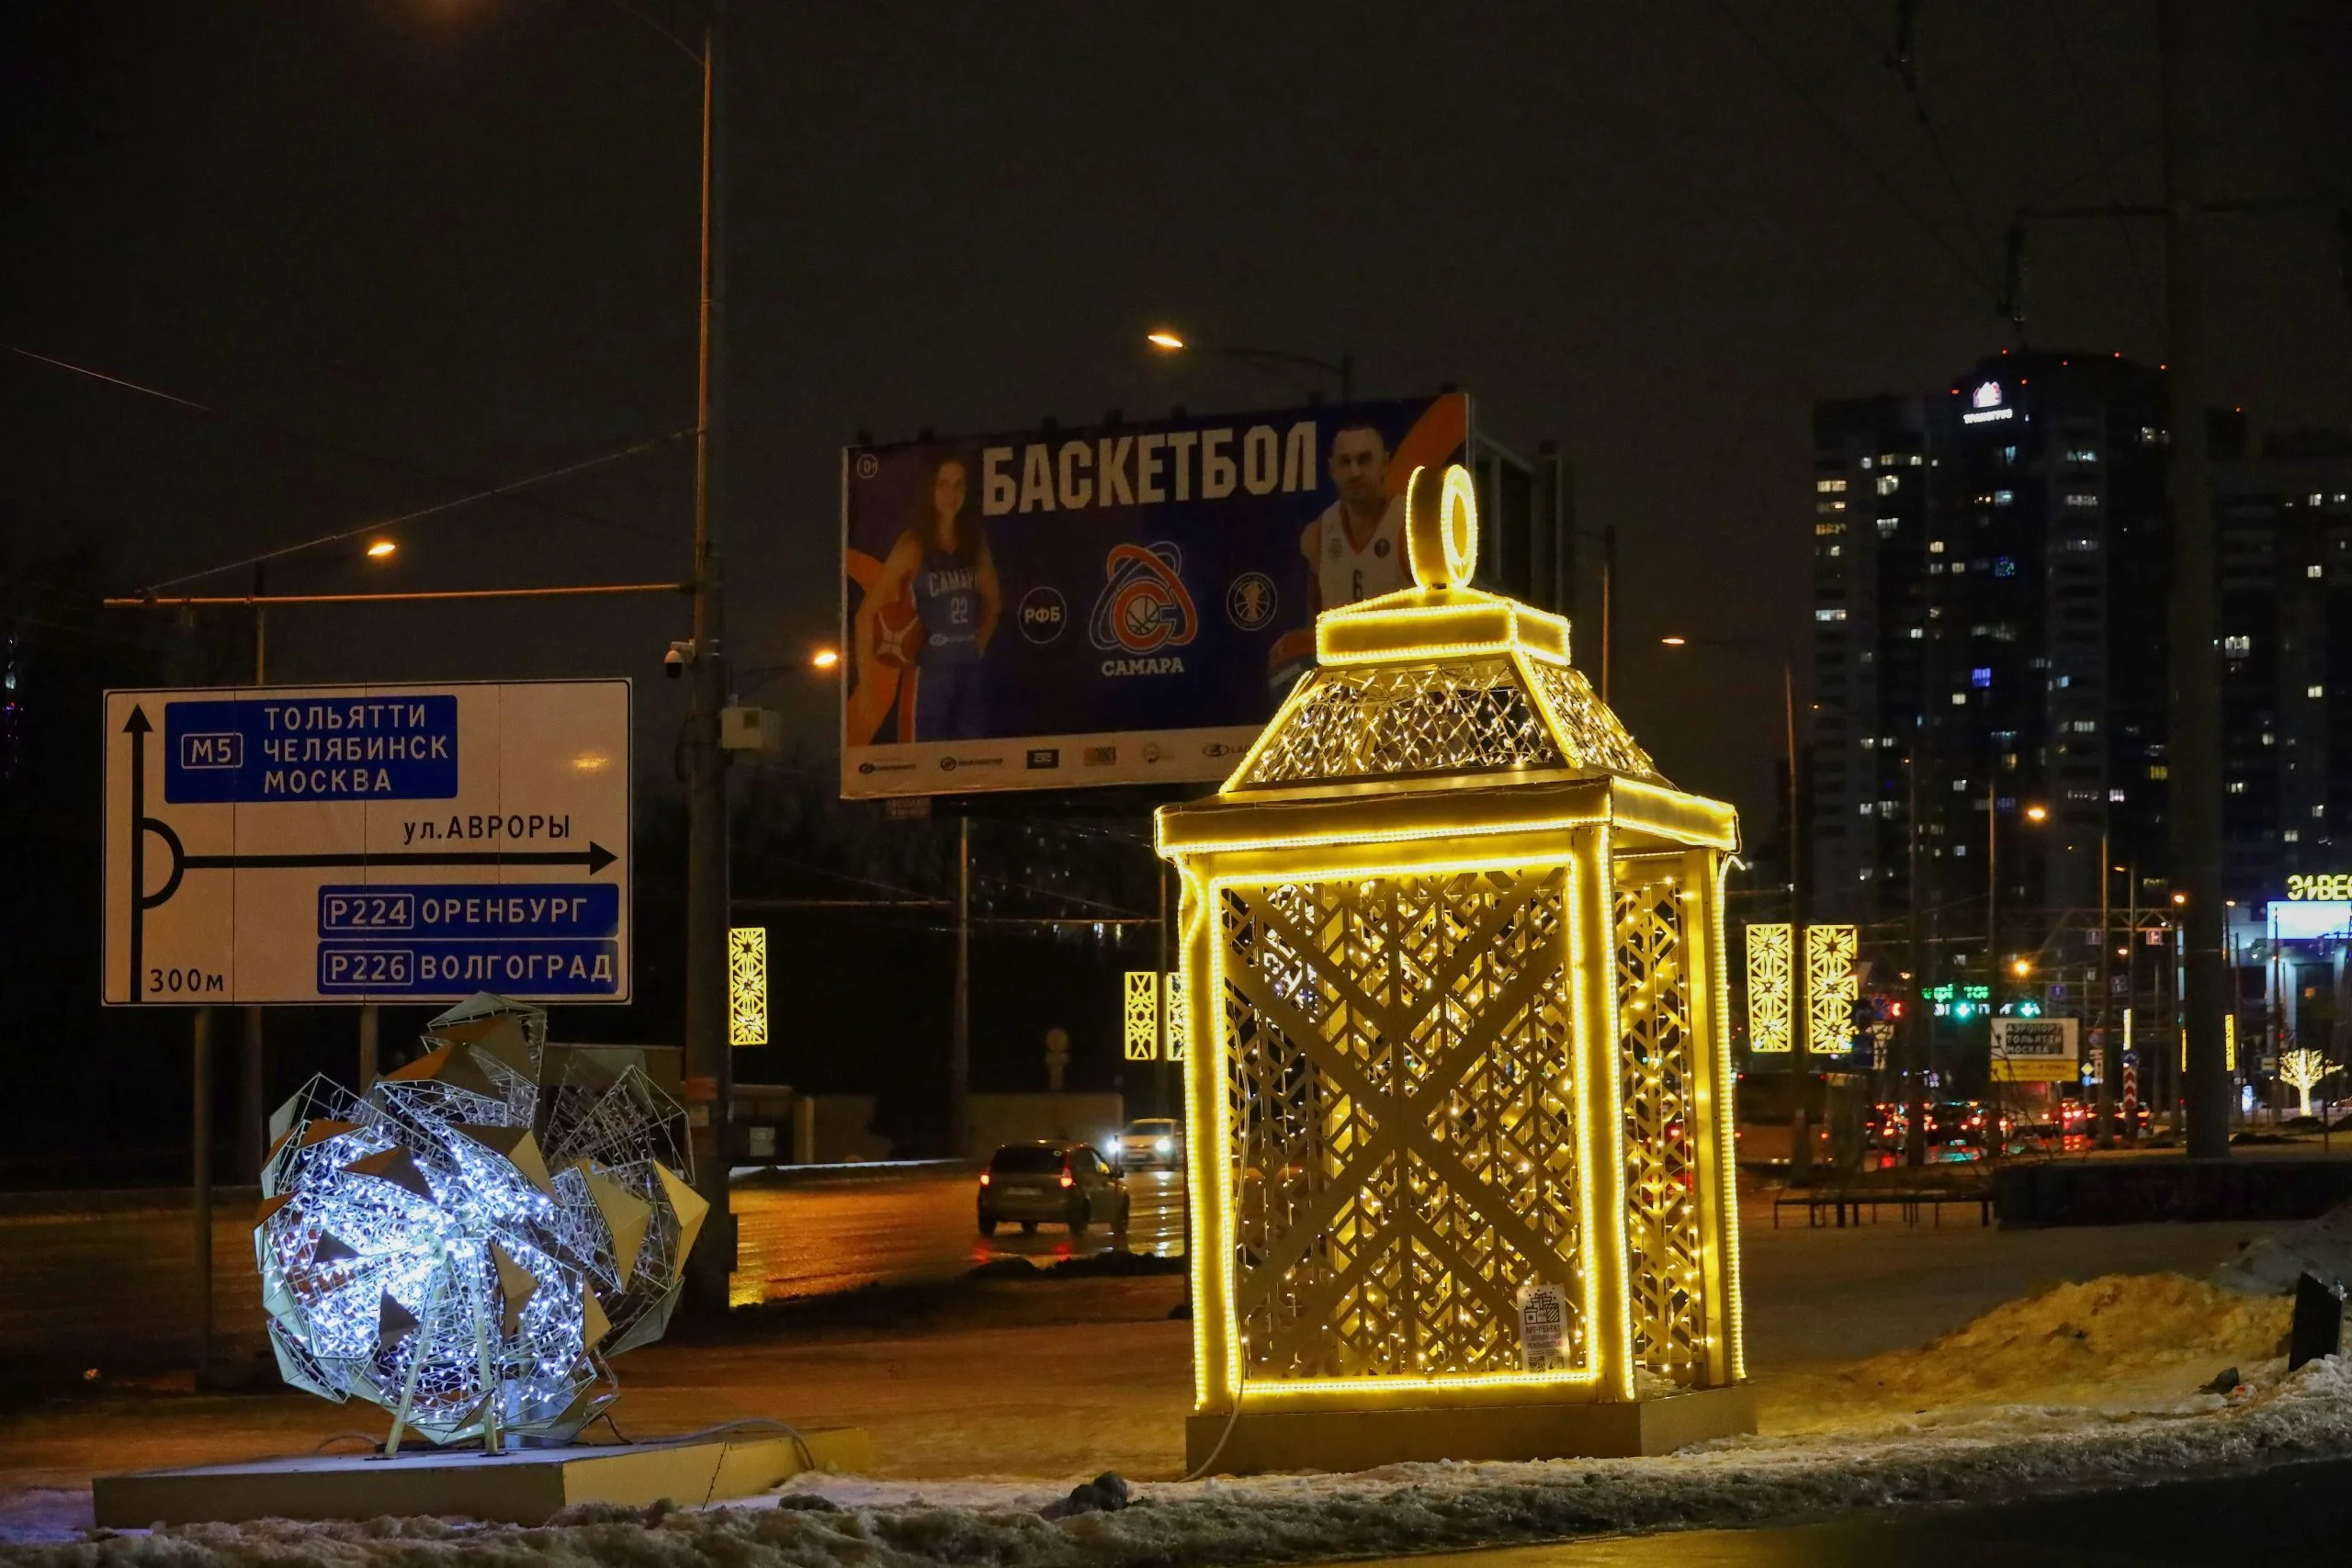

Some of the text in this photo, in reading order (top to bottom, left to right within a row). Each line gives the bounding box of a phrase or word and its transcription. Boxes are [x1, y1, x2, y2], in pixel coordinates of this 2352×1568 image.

[982, 420, 1317, 516] БАСКЕТБОЛ
[1352, 569, 1363, 603] 6
[951, 595, 969, 625] 22
[1023, 605, 1062, 625] РФБ
[1102, 658, 1184, 677] САМАРА
[264, 704, 426, 731] ТОЛЬЯТТИ
[190, 739, 232, 763] М5
[264, 735, 450, 763] ЧЕЛЯБИНСК
[264, 768, 392, 795] МОСКВА
[402, 815, 571, 846] ул.АВРОРЫ
[330, 899, 407, 925] Р224
[421, 897, 588, 925] ОРЕНБУРГ
[150, 968, 224, 994] 300м
[330, 955, 406, 981] Р226
[421, 953, 613, 984] ВОЛГОГРАД
